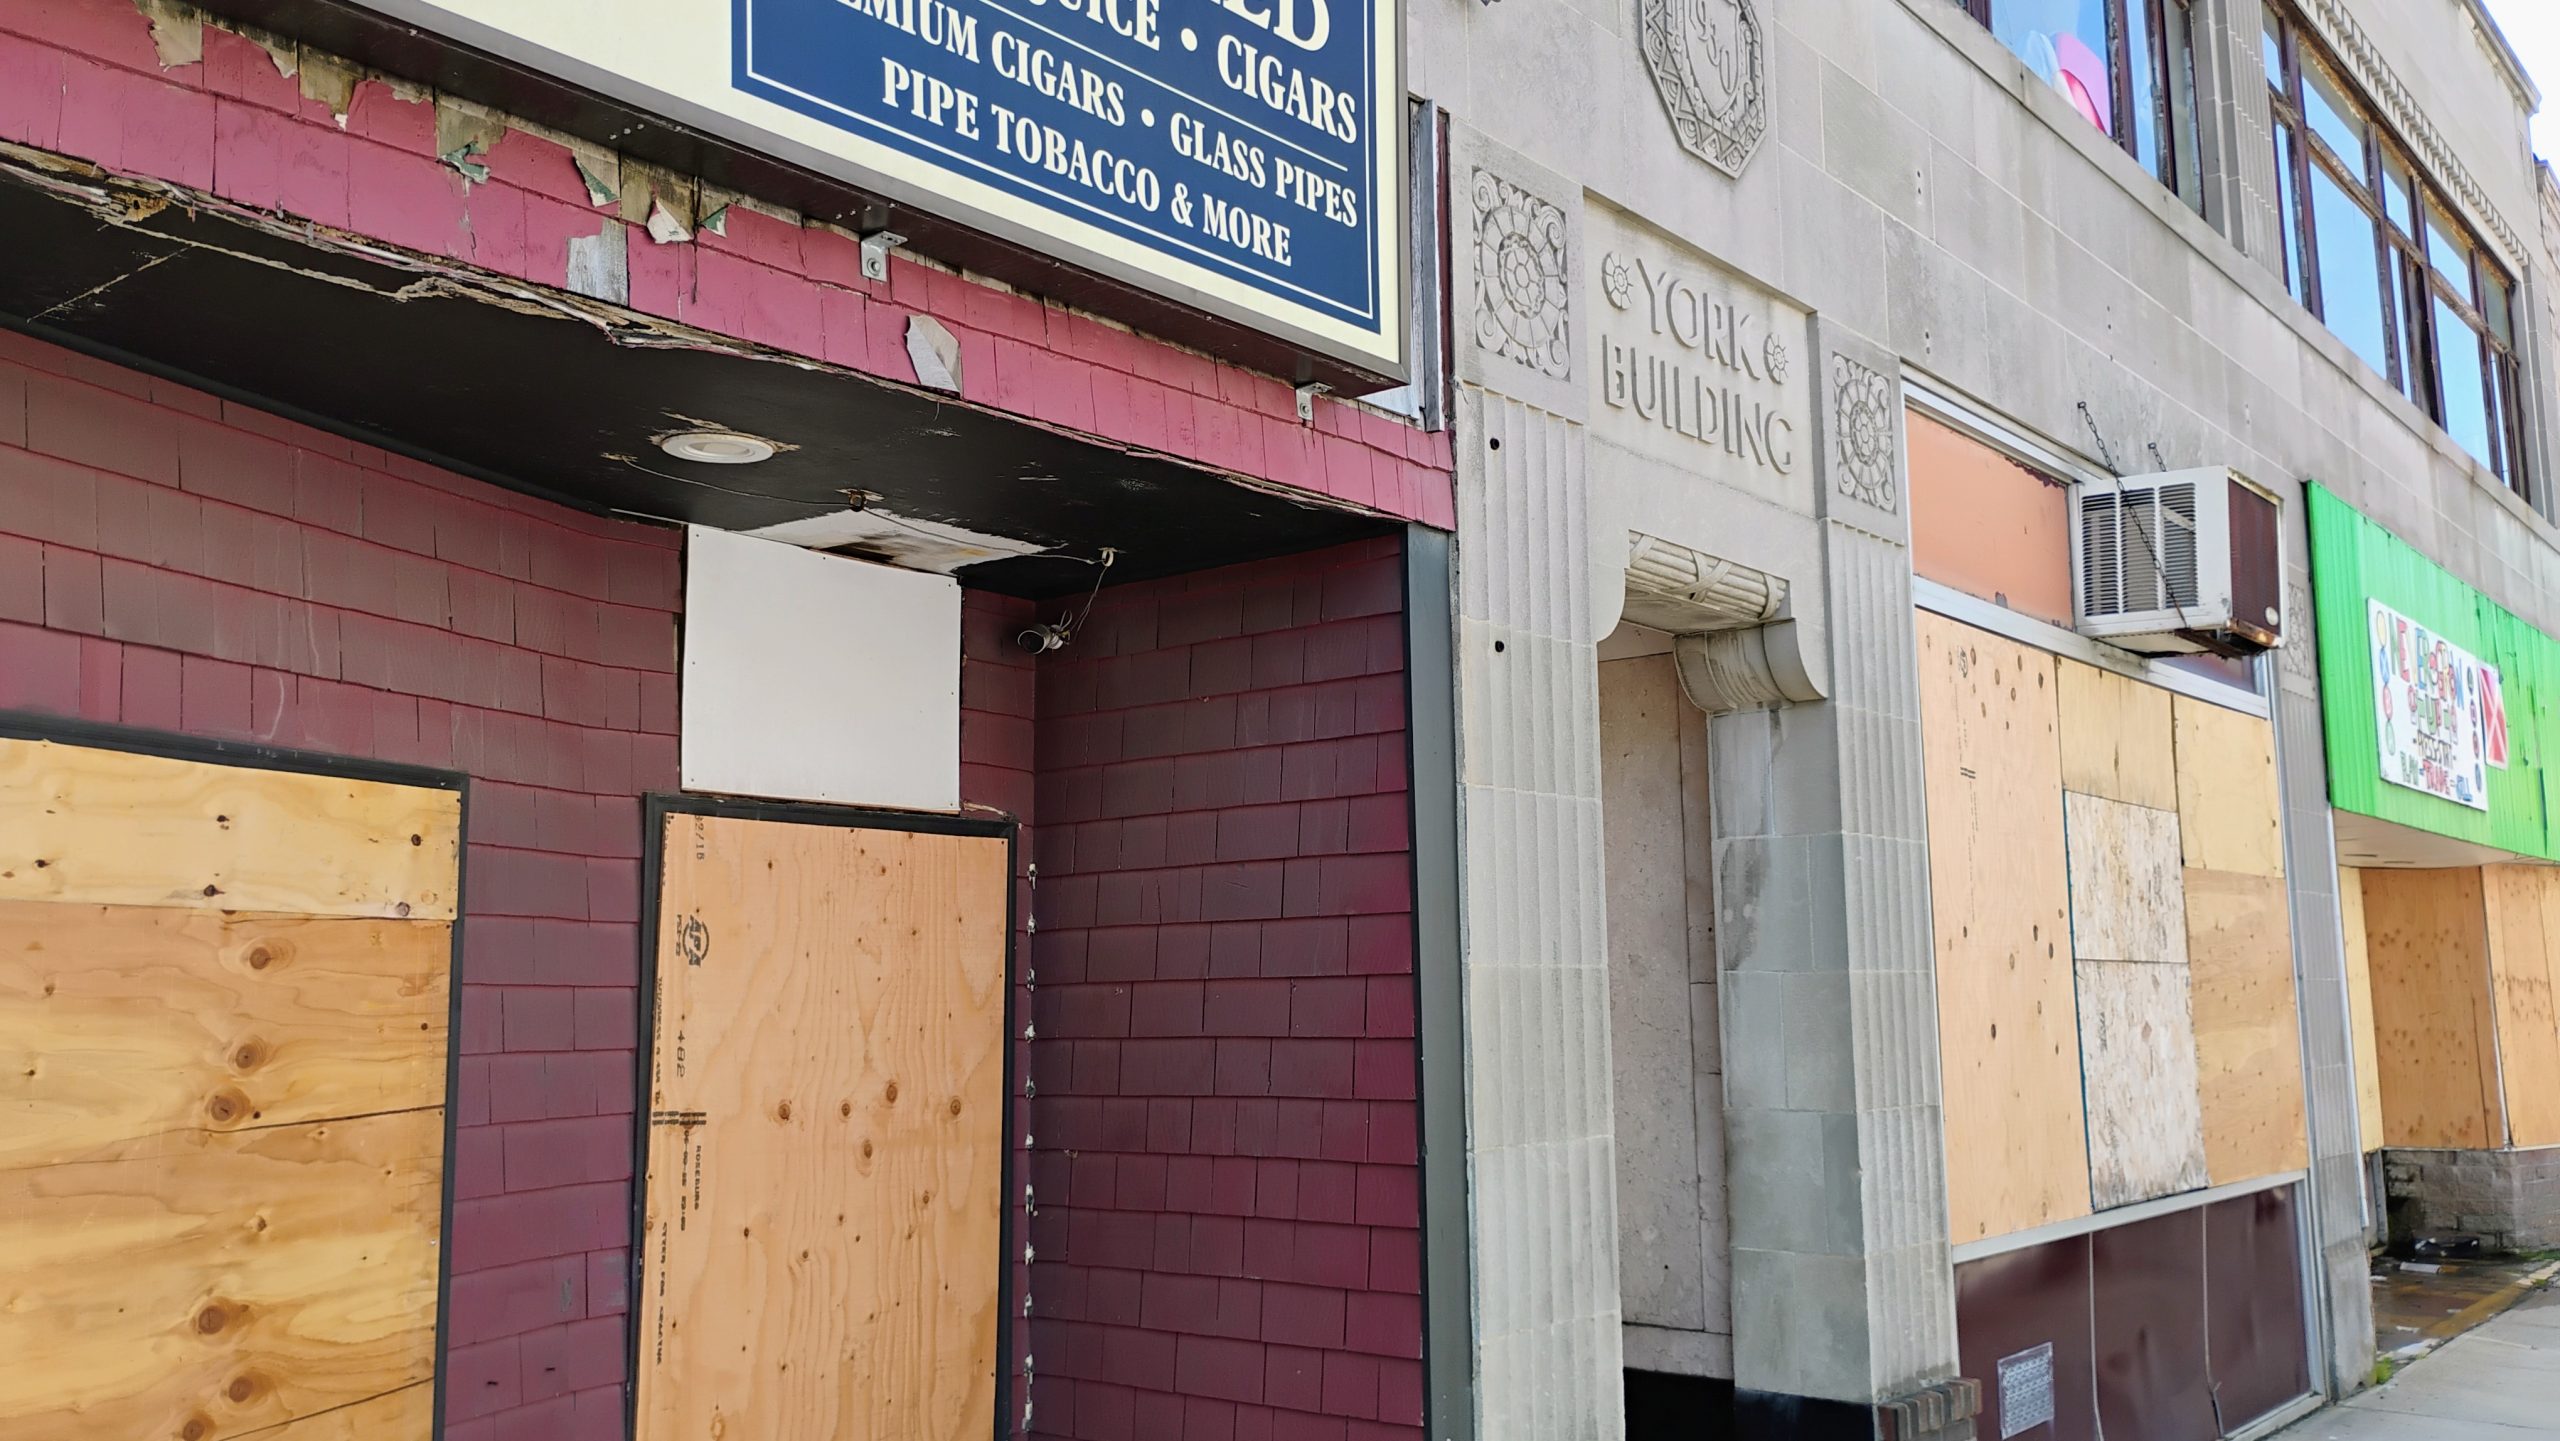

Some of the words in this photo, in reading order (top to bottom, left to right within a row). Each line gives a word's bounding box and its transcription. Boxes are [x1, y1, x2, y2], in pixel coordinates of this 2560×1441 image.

[836, 0, 980, 64] MIUM
[991, 31, 1126, 127] CIGARS
[1170, 112, 1266, 189] GLASS
[1275, 157, 1358, 228] PIPES
[1217, 34, 1360, 145] CIGARS
[881, 56, 980, 141] PIPE
[991, 104, 1161, 213] TOBACCO
[1171, 182, 1194, 228] &
[1203, 193, 1292, 267] MORE
[1635, 257, 1761, 381] YORK
[1601, 333, 1794, 475] BUILDING
[688, 914, 702, 968] APA
